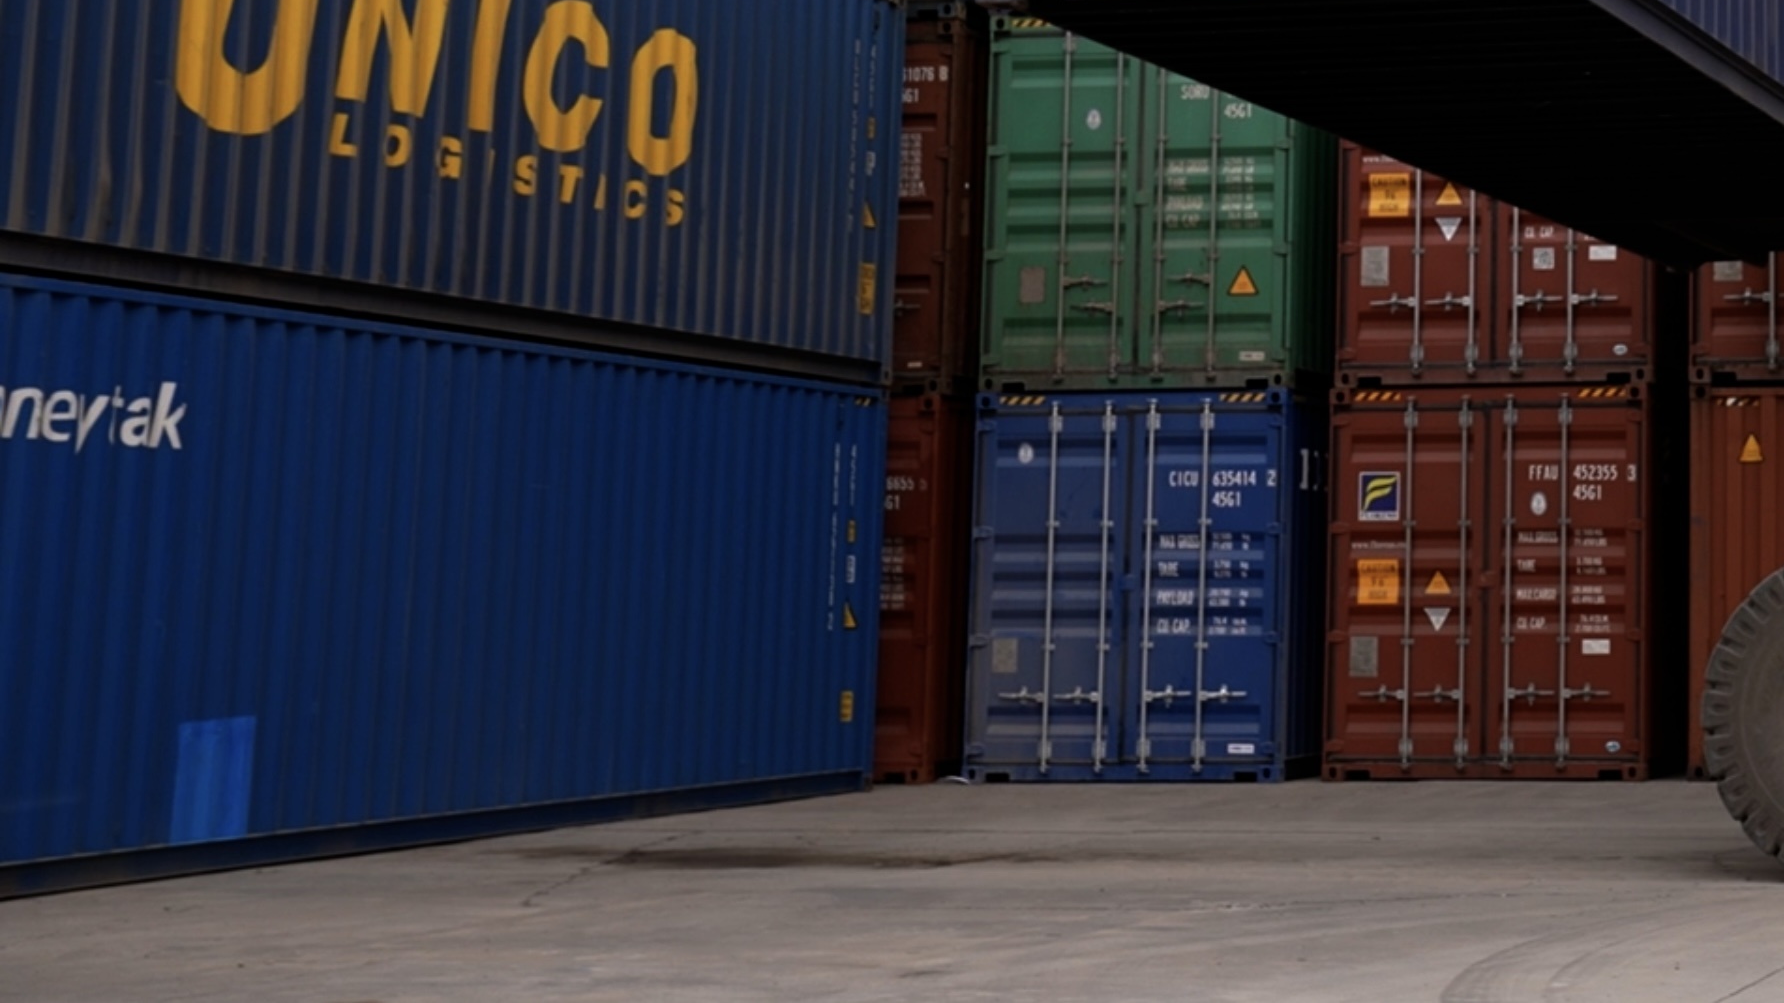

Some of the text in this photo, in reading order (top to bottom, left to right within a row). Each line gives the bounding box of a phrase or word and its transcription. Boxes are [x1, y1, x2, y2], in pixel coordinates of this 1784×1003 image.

[0, 381, 188, 454] neytak
[1212, 491, 1241, 507] 45G1
[1573, 484, 1602, 500] 45G1
